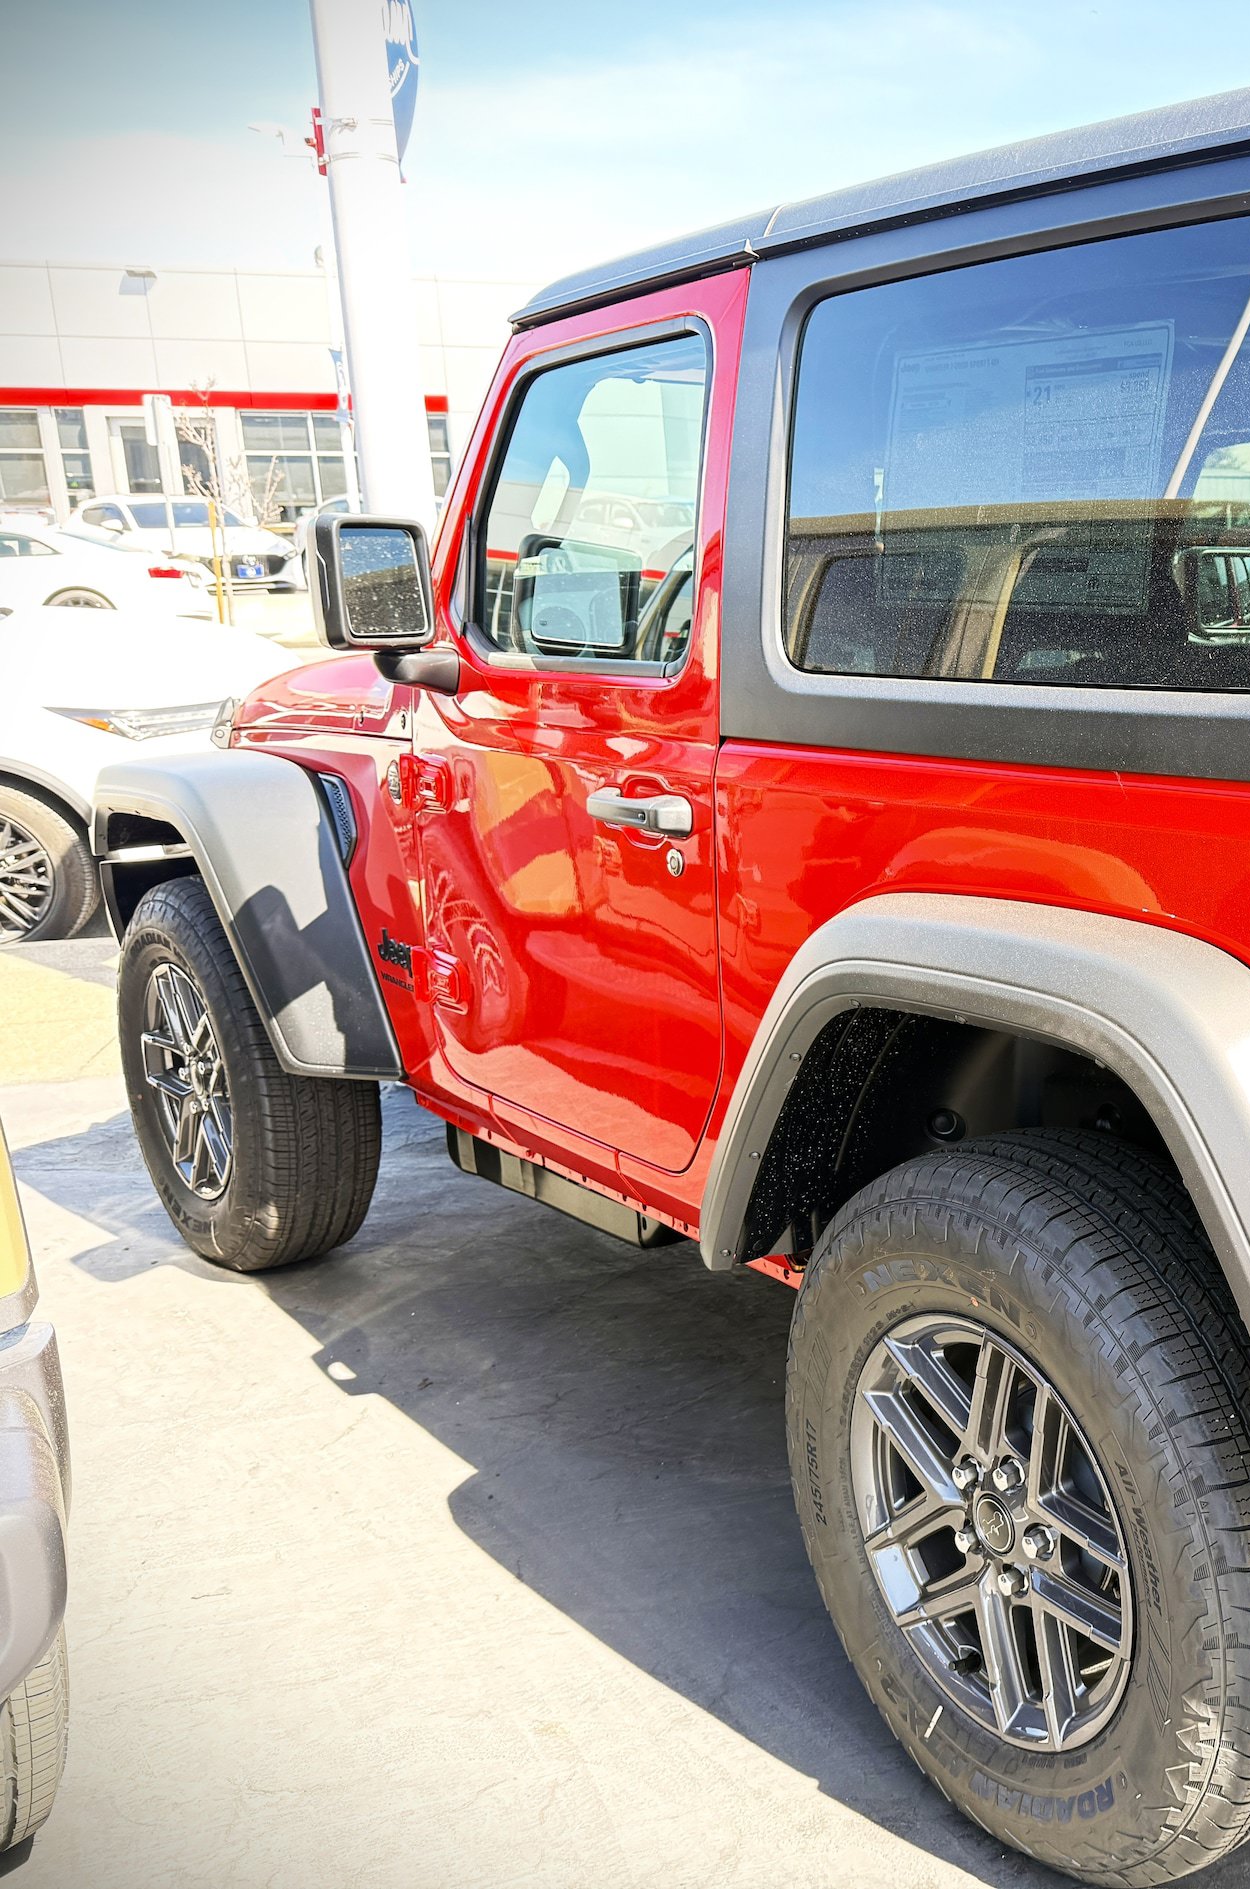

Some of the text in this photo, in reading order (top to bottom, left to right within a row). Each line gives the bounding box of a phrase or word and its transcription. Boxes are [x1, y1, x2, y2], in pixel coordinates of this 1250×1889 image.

[1034, 386, 1051, 406] 21
[162, 1183, 216, 1234] NEXEN
[863, 1260, 1019, 1328] NEXEN
[806, 1418, 826, 1525] 245/75R17
[1114, 1461, 1162, 1616] All-Weather
[967, 1769, 1113, 1823] ROADIAN
